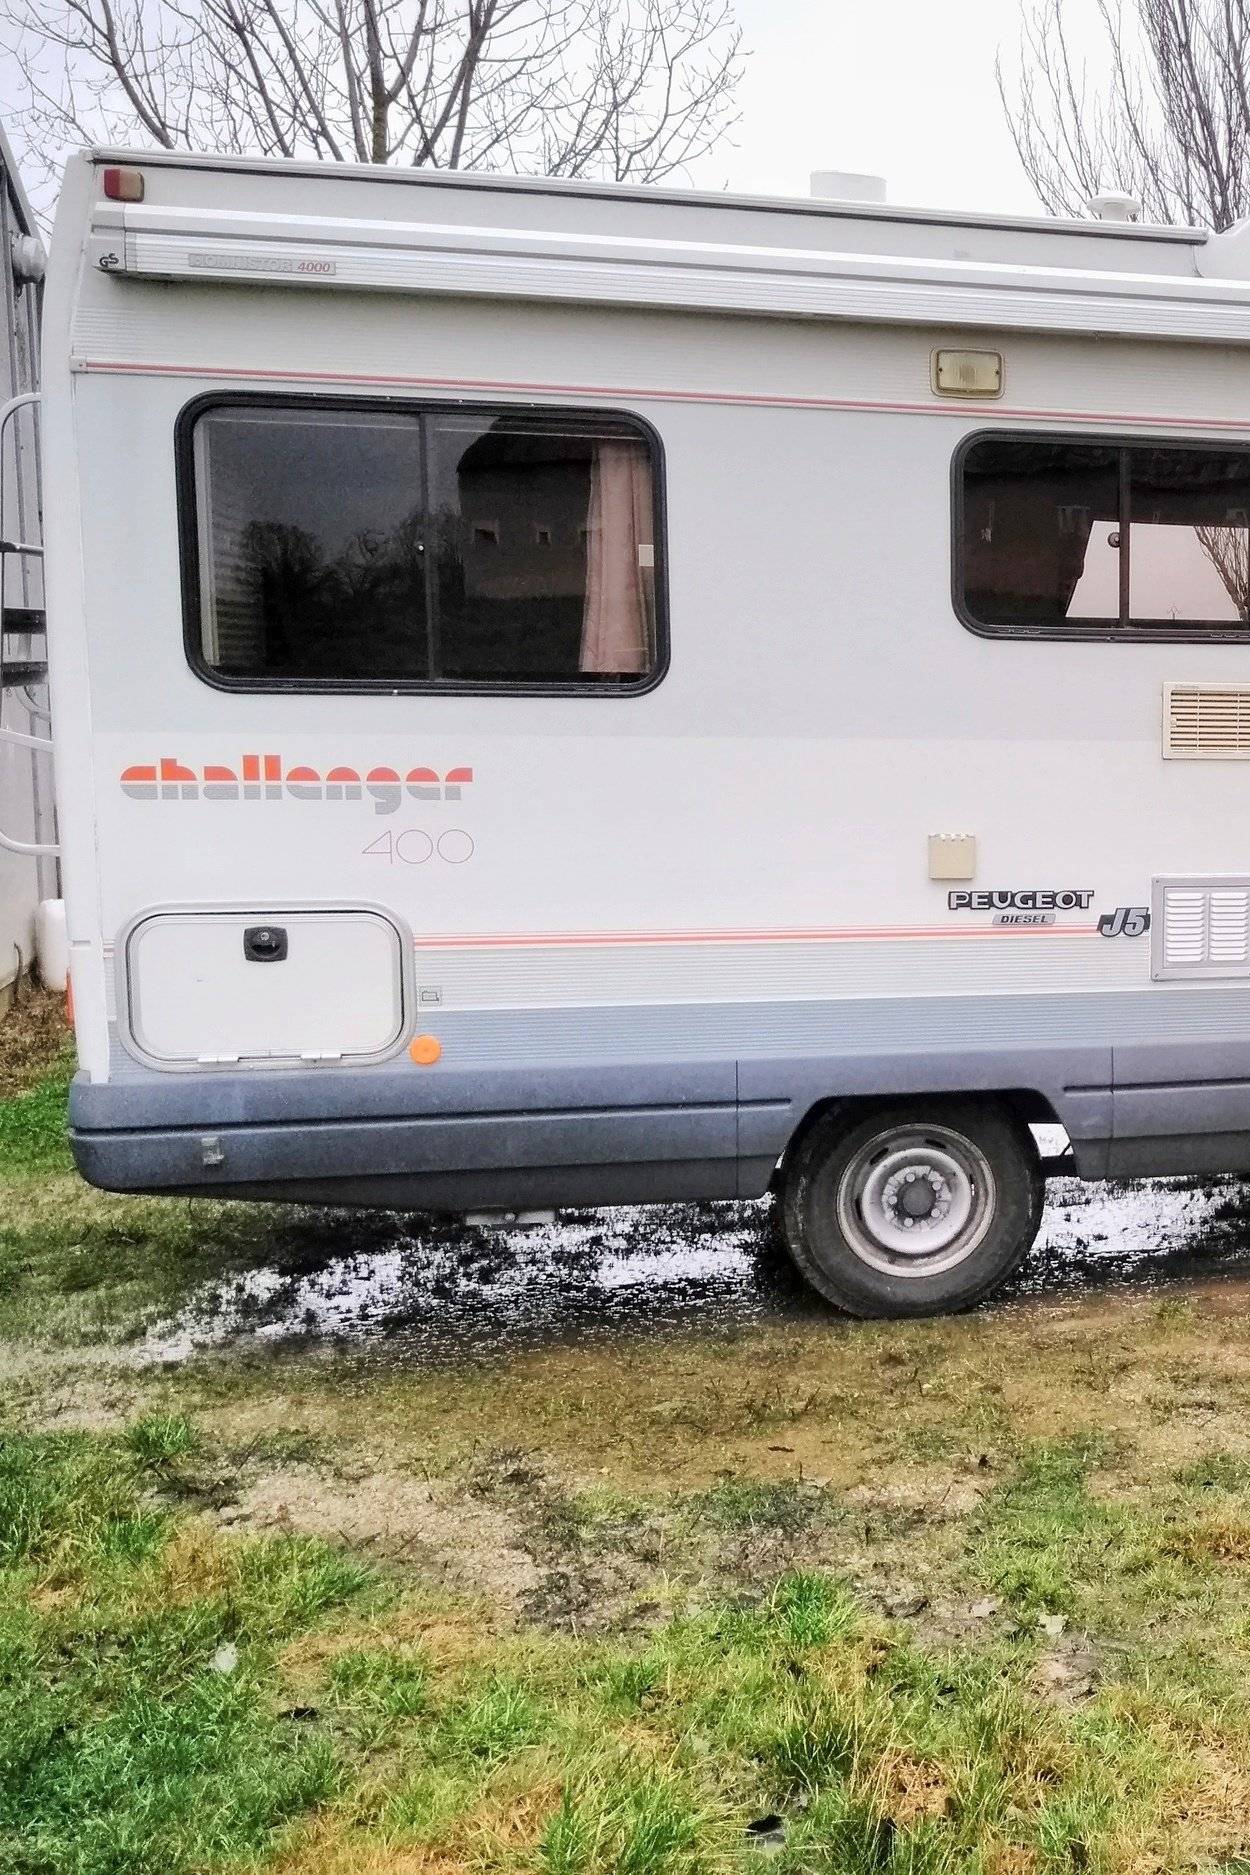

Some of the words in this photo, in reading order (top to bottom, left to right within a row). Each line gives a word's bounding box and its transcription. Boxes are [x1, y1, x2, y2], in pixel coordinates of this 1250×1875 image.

[298, 261, 331, 272] 4000
[120, 754, 473, 815] challenger
[361, 829, 474, 864] 400
[948, 890, 1095, 910] PEUGEOT
[1000, 914, 1050, 924] DIESEL
[1101, 907, 1149, 937] J5
